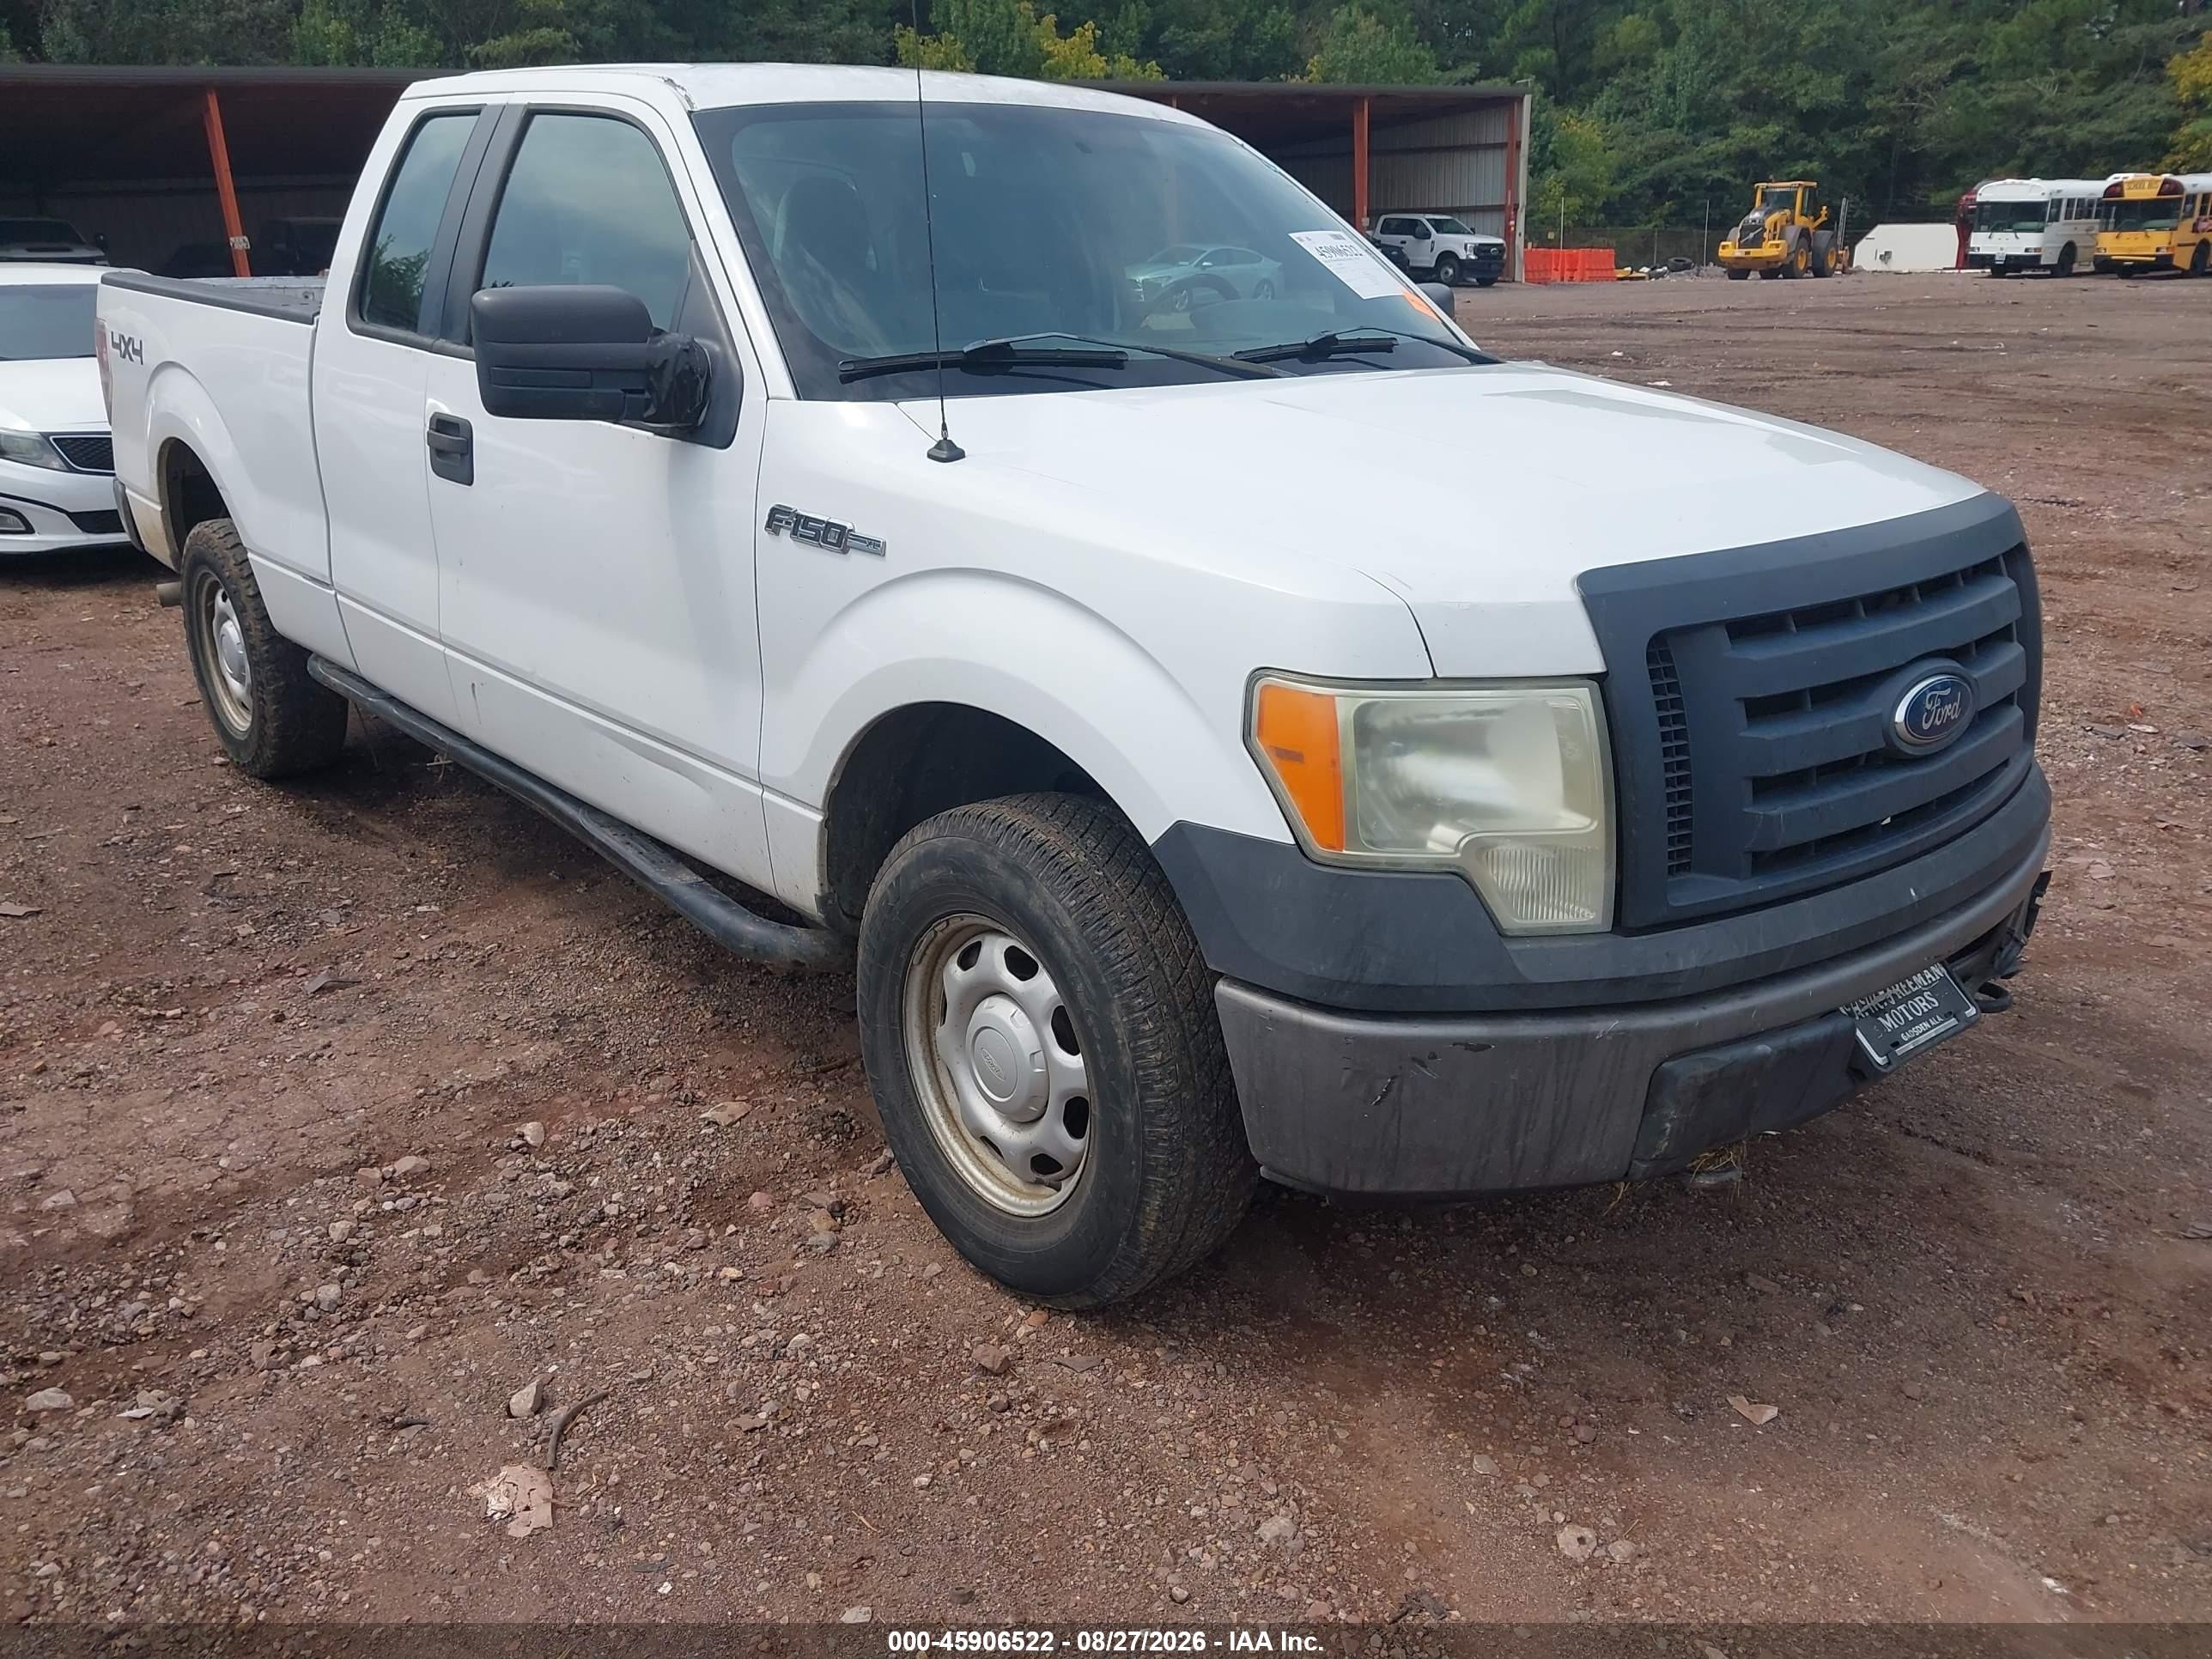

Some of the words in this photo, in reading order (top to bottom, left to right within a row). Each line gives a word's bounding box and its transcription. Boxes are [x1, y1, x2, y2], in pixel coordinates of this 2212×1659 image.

[1922, 687, 1961, 730] Ford
[1877, 991, 1939, 1032] MOTORS
[1900, 1021, 1931, 1042] GADSDEN
